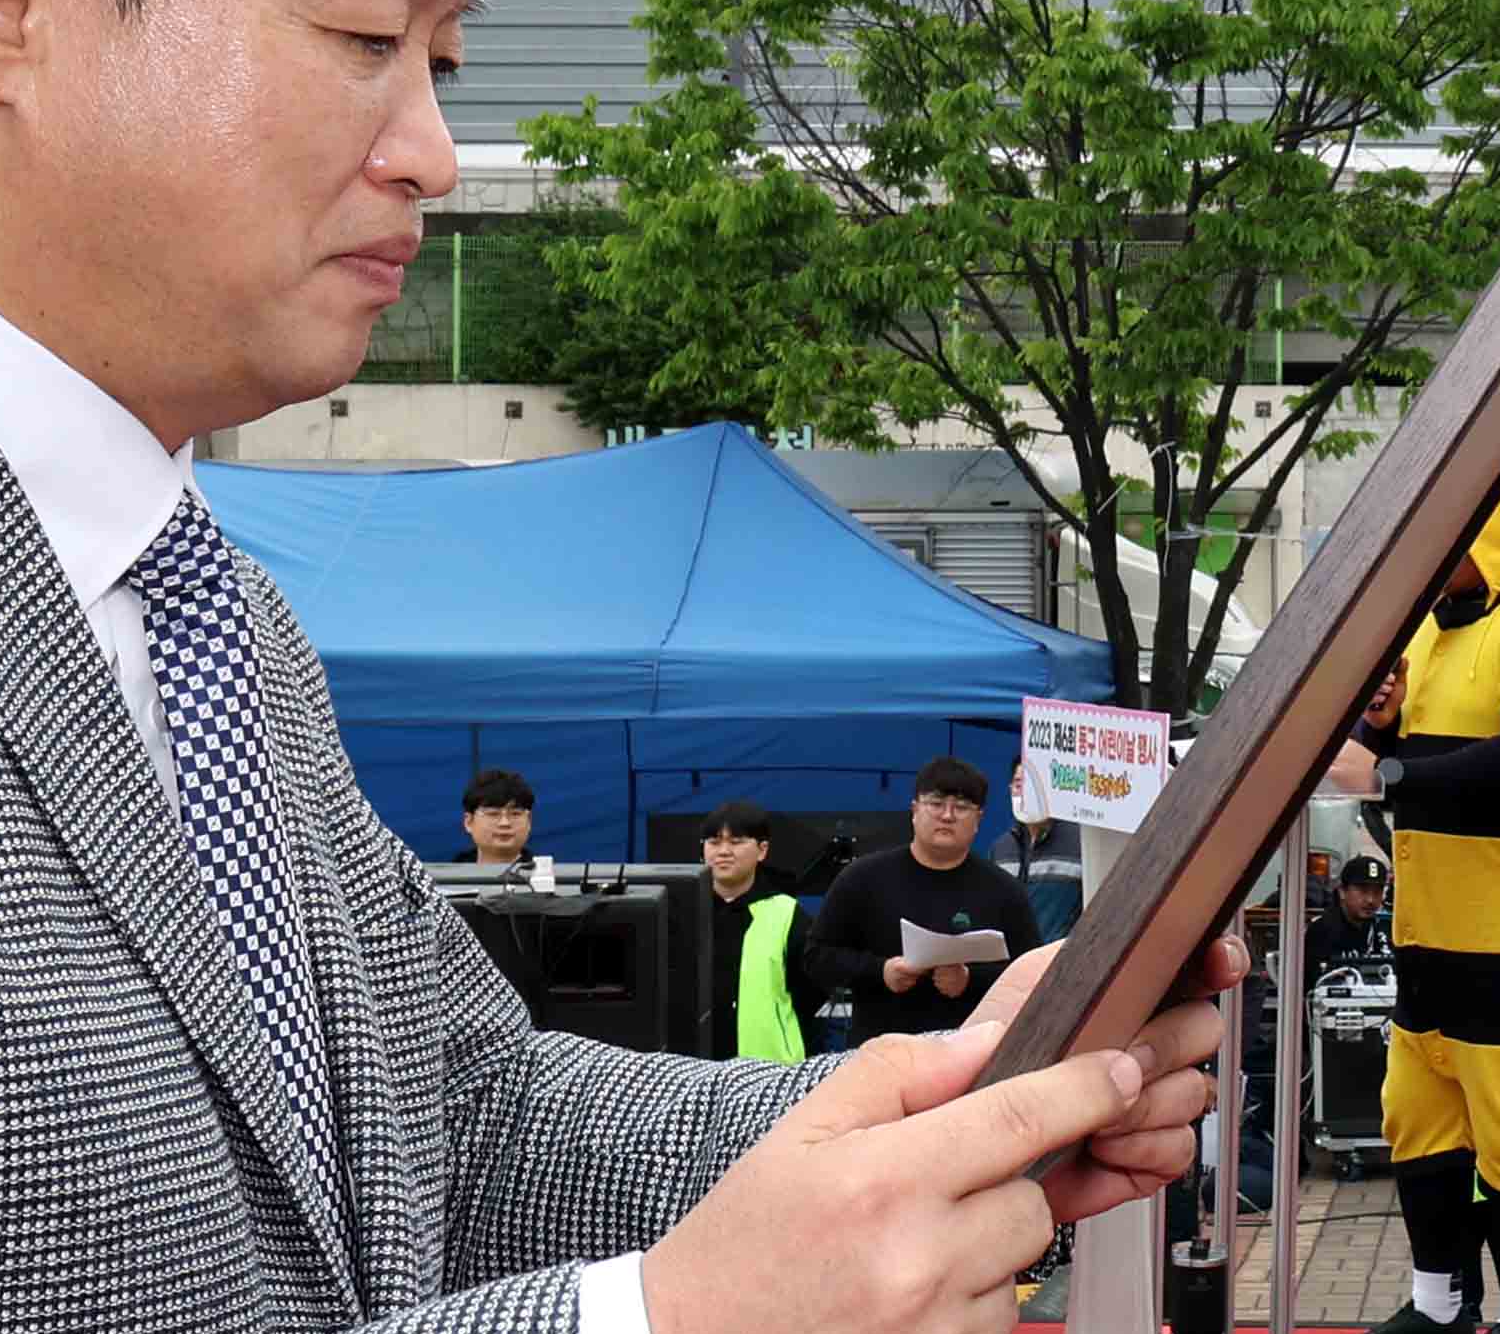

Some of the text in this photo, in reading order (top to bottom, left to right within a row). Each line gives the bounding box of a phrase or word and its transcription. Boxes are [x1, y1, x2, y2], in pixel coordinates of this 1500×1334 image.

[1028, 719, 1051, 749] 2023
[1053, 722, 1077, 753] 제6회
[1079, 725, 1096, 757] 동구
[1098, 727, 1136, 764] 어린이날
